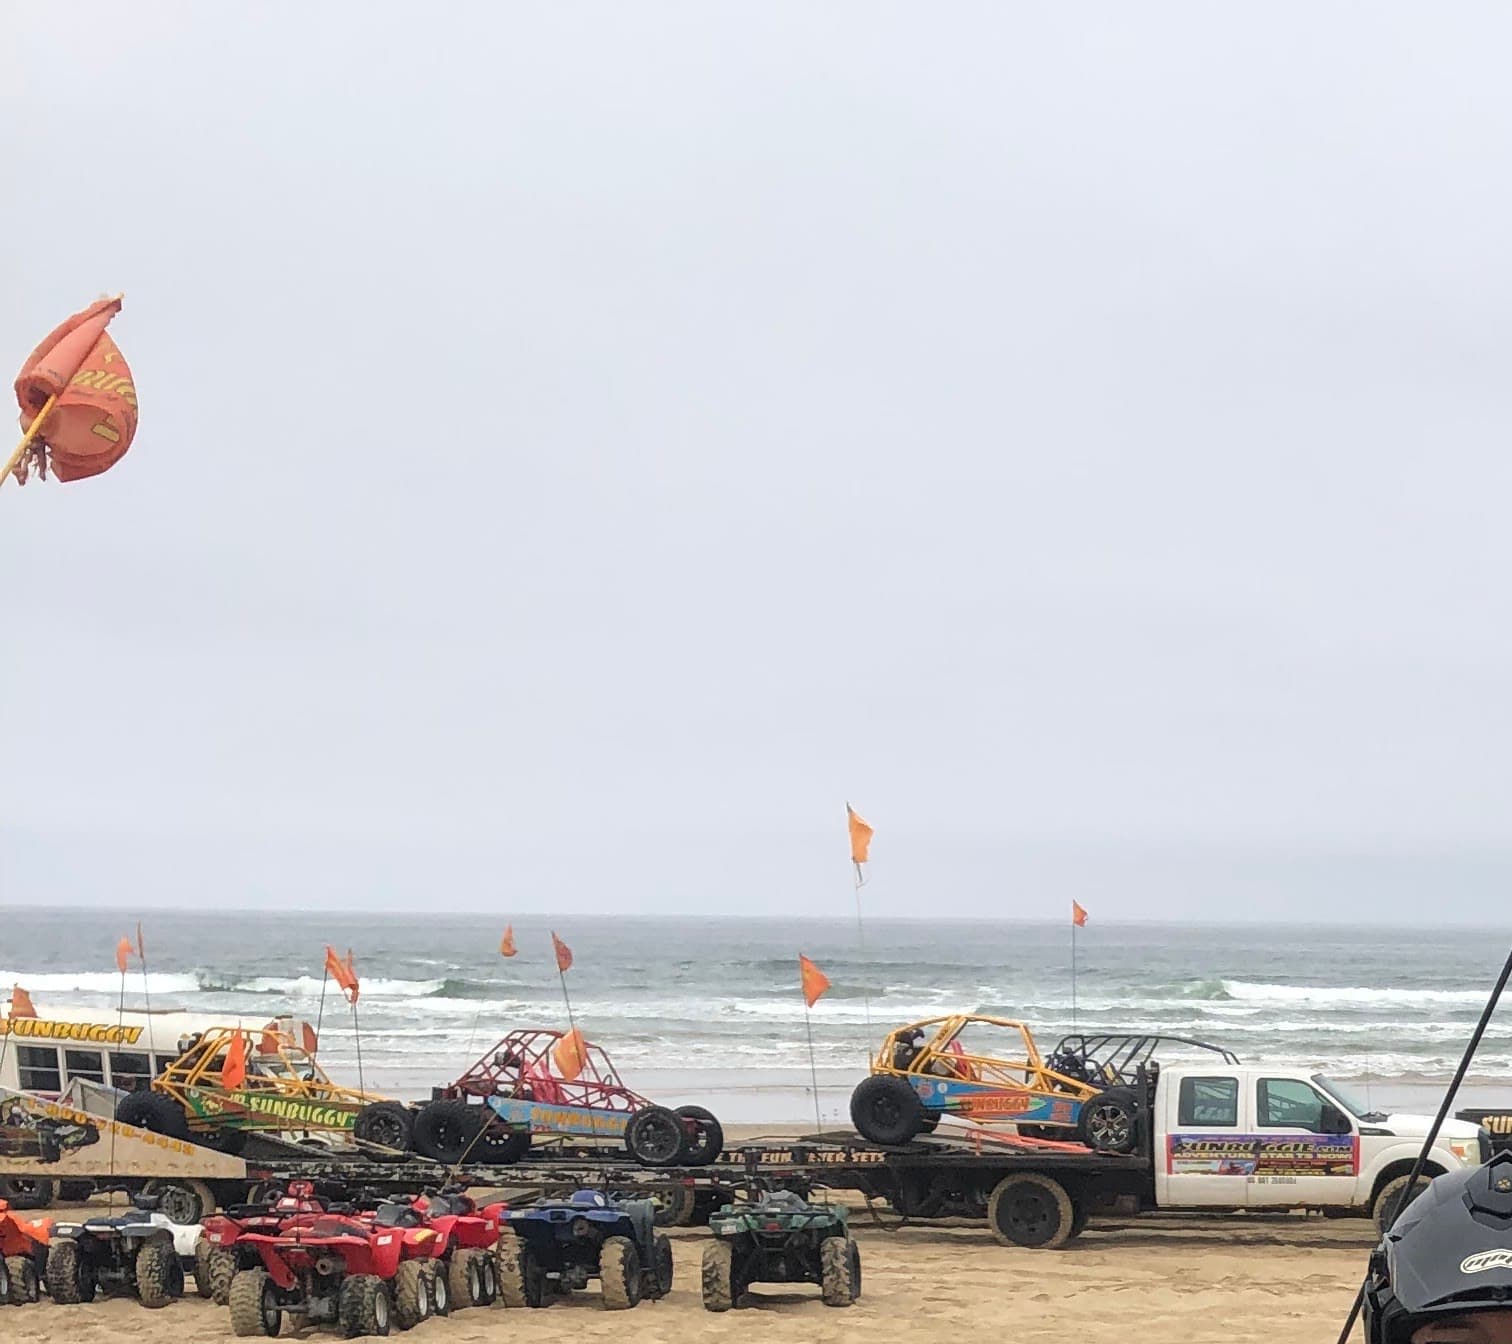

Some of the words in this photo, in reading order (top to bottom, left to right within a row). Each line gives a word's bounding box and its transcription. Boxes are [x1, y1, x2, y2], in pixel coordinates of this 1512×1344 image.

[249, 1096, 350, 1127] SUNBUGGY
[761, 1152, 793, 1163] FUN
[852, 1152, 889, 1163] SETS
